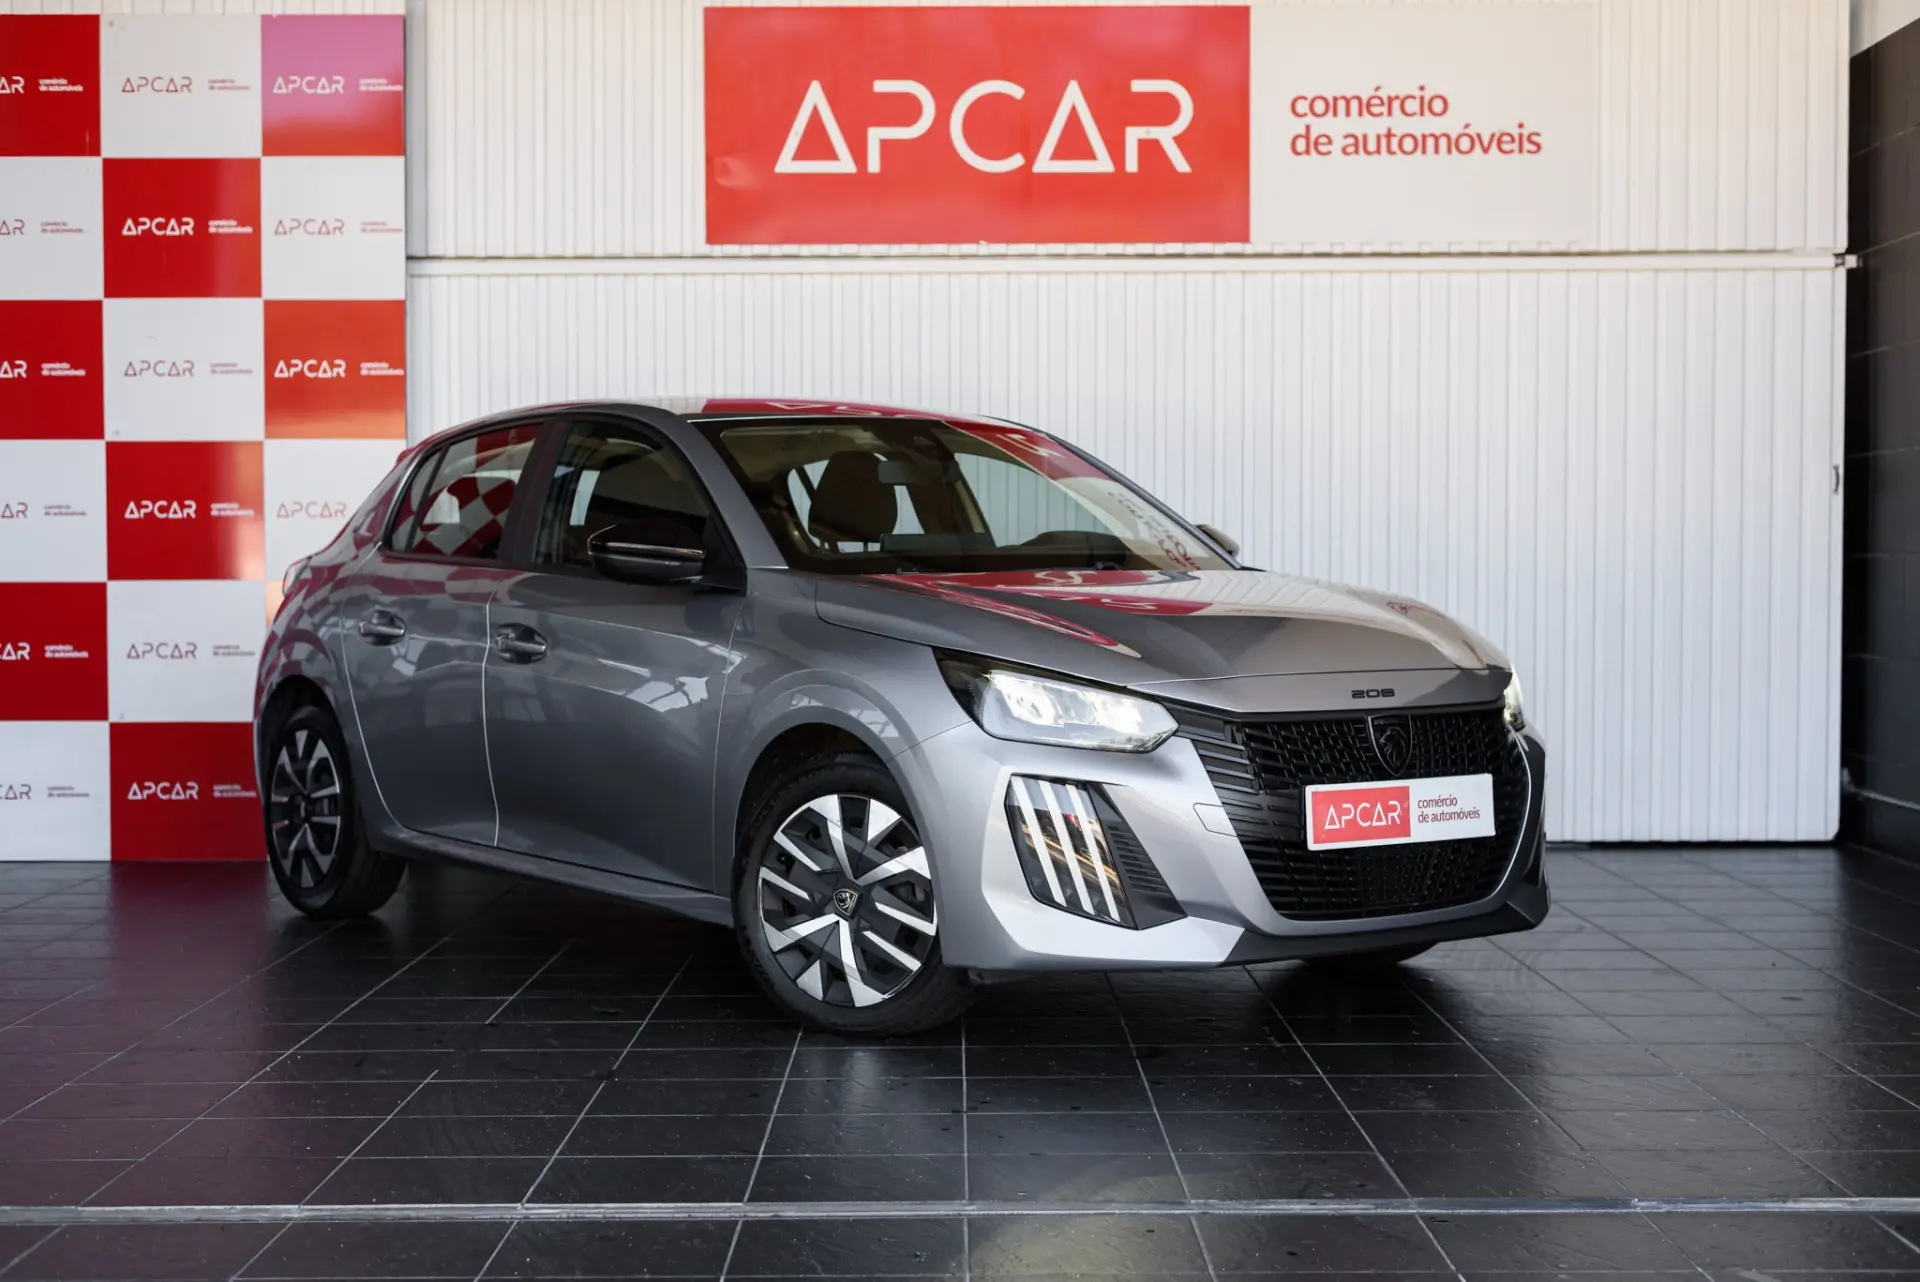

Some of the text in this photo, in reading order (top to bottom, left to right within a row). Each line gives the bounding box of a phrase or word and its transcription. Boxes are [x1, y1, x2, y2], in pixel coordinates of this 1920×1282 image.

[122, 76, 192, 93] APCAR
[272, 76, 345, 94] APCAR
[1290, 85, 1449, 119] comércio
[773, 79, 1195, 174] APCAR
[1290, 123, 1543, 157] de automóveis
[122, 217, 195, 236] APCAR
[274, 218, 345, 236] APCAR
[124, 359, 195, 377] APCAR
[274, 359, 346, 378] APCAR
[124, 500, 197, 519] APCAR
[276, 501, 347, 519] APCAR
[0, 642, 30, 660] AR
[127, 642, 198, 659] APCAR
[1351, 688, 1396, 700] 208
[0, 783, 31, 801] AR
[127, 781, 199, 800] APCAR
[1417, 794, 1458, 810] comércio
[1323, 800, 1402, 830] APCAR
[1417, 806, 1481, 824] de automóveis
